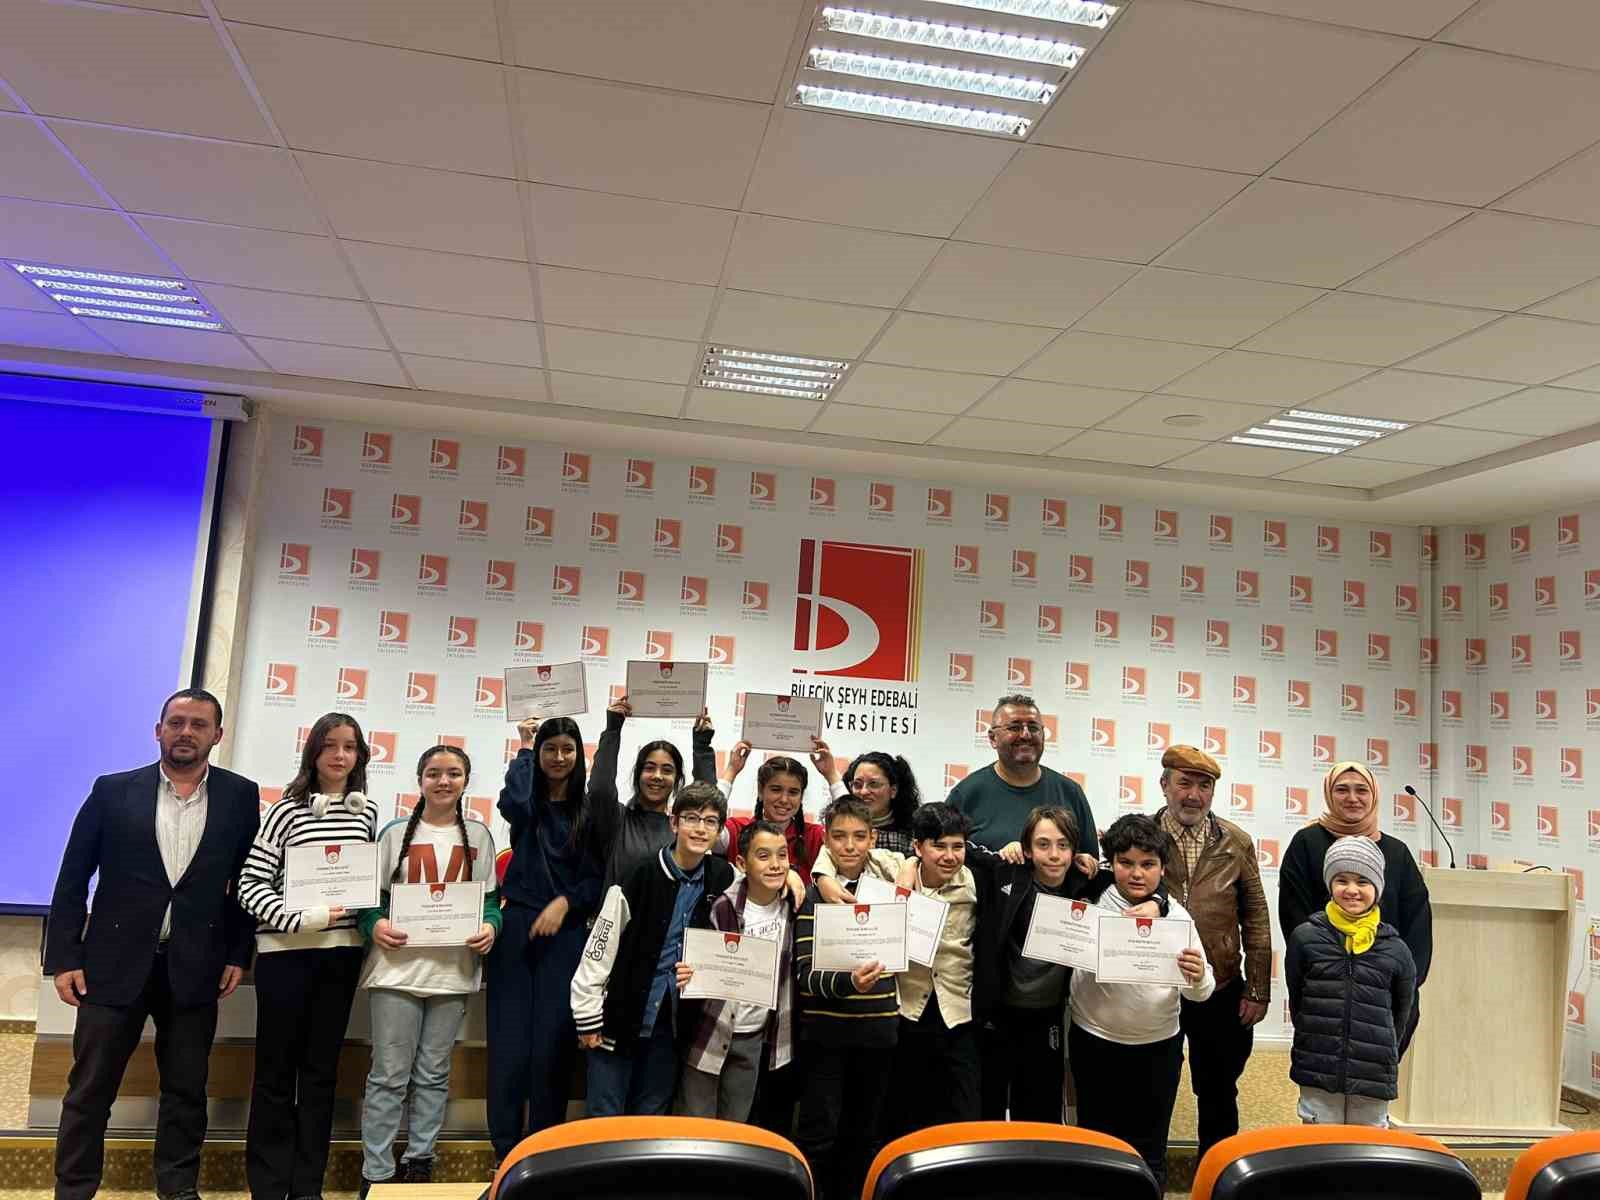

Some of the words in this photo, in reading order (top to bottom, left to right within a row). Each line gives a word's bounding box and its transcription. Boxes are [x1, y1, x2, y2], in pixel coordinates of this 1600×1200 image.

[838, 687, 867, 708] ŞEYH
[871, 688, 918, 709] EDEBALİ
[825, 709, 917, 735] VERSİTESİ
